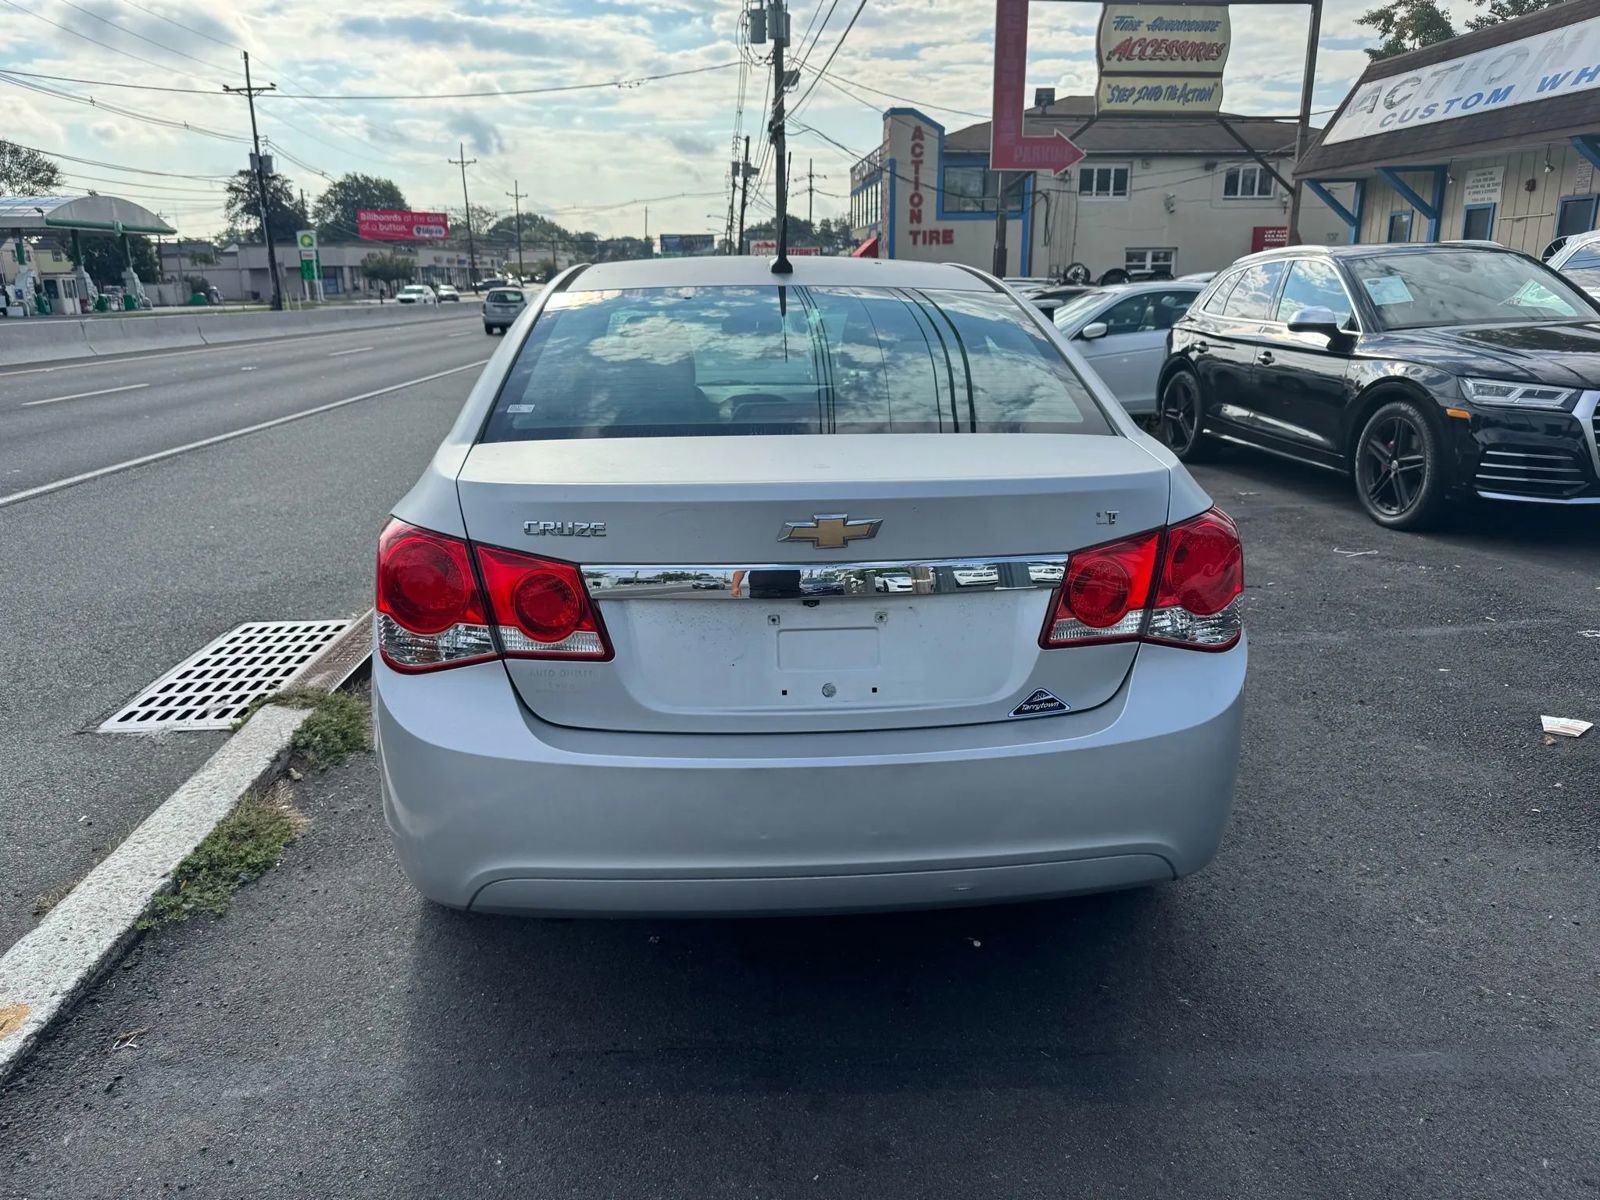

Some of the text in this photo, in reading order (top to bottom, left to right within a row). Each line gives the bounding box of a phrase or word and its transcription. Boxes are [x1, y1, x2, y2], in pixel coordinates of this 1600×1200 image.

[1106, 36, 1227, 62] ACCESSORIES
[1379, 84, 1516, 128] CUSTOM
[908, 125, 925, 225] ACTION
[360, 212, 401, 222] Billboards
[909, 229, 955, 246] TIRE
[1096, 510, 1120, 525] LT
[523, 520, 607, 538] CRUZE
[1021, 701, 1060, 711] Tarrytown
